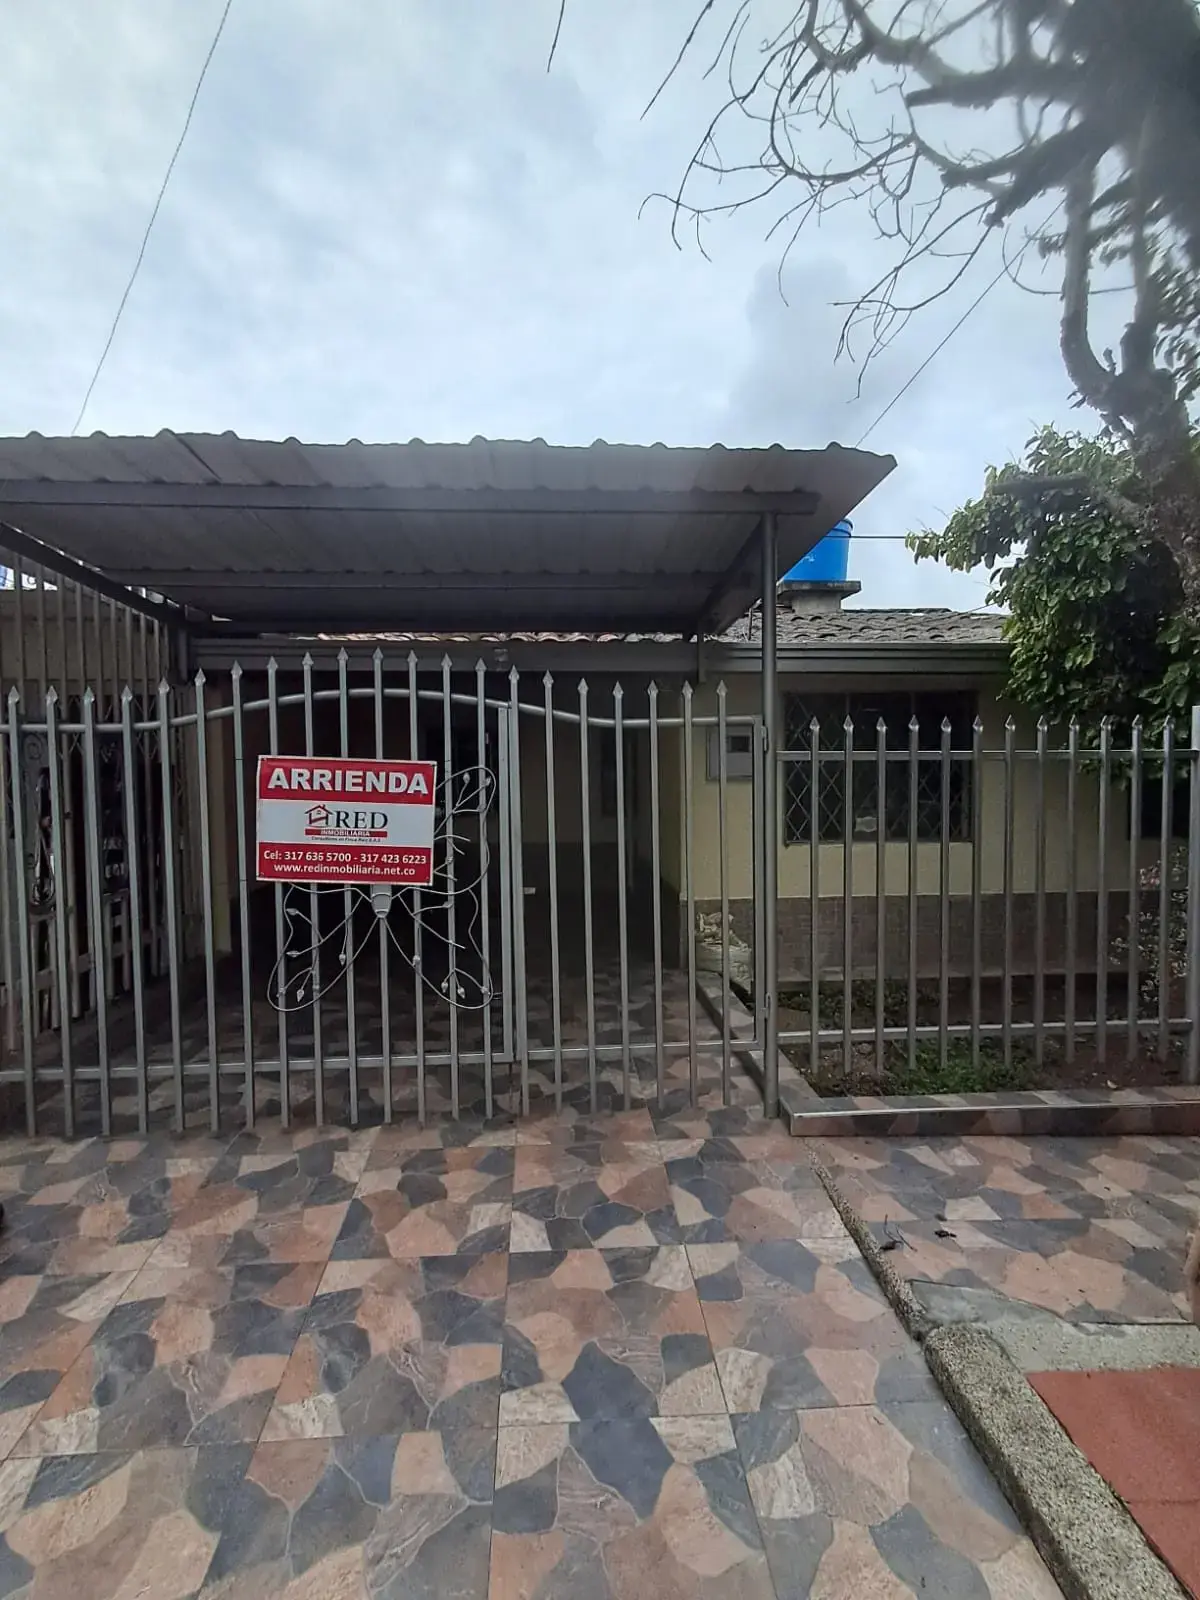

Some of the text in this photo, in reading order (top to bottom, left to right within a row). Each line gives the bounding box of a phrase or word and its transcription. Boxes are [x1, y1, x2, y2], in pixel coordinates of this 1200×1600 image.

[267, 767, 428, 794] ARRIENDA
[335, 810, 388, 829] RED
[320, 829, 370, 837] INMOBILIARIA
[263, 850, 282, 860] Cel:
[284, 851, 303, 860] 317
[326, 852, 351, 862] 5700
[360, 853, 379, 863] 317
[381, 854, 399, 863] 423
[402, 854, 426, 864] 6223
[273, 864, 416, 876] www.redinmobiliaria.net.co
